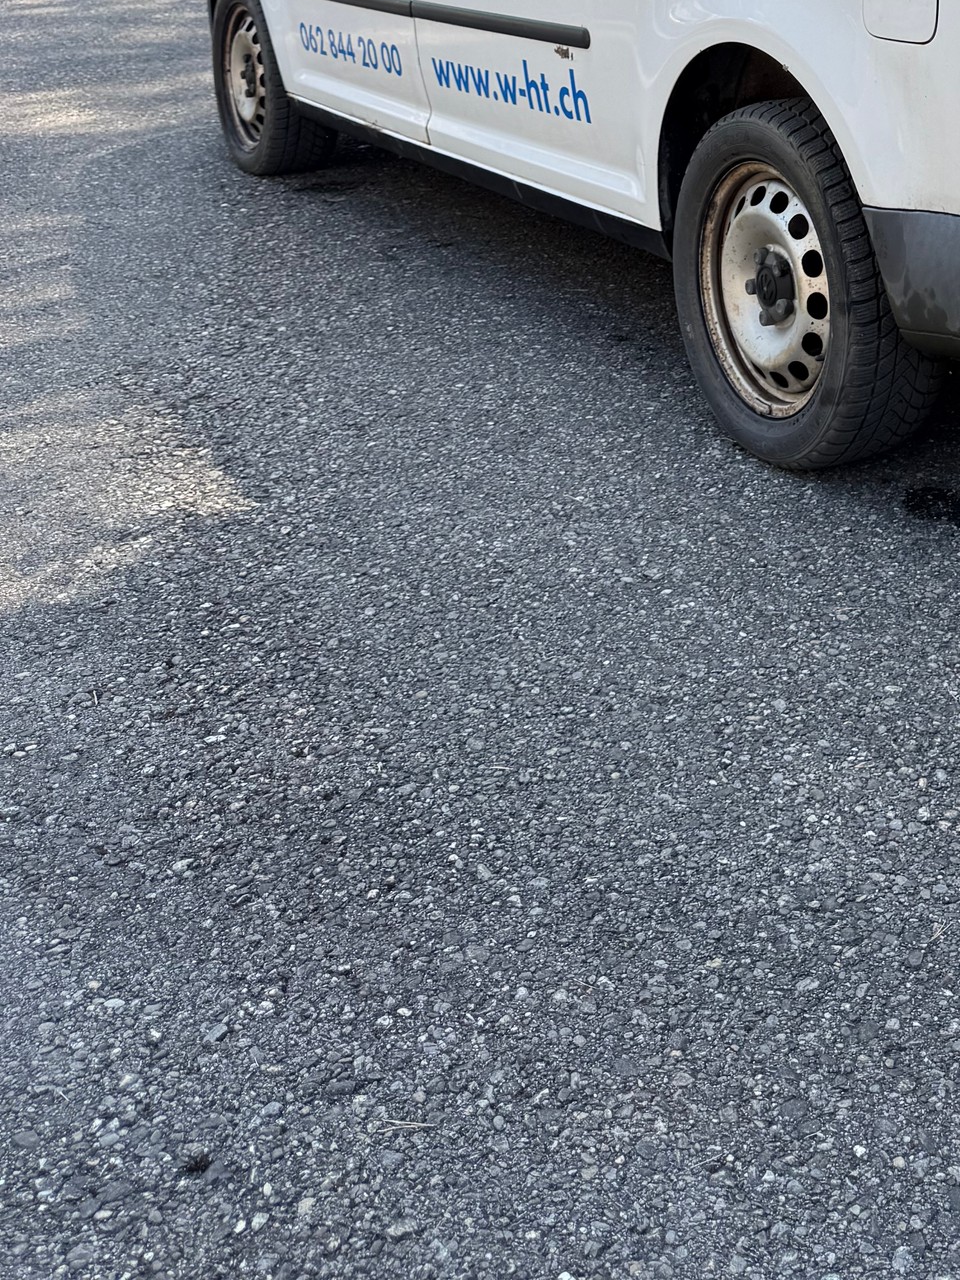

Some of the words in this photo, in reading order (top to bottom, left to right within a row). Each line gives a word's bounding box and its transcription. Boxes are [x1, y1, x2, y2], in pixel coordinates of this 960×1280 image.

[299, 22, 328, 56] 062
[328, 29, 356, 64] 844
[357, 35, 379, 70] 20
[380, 41, 403, 77] 00
[431, 57, 592, 124] www.w-ht.ch
